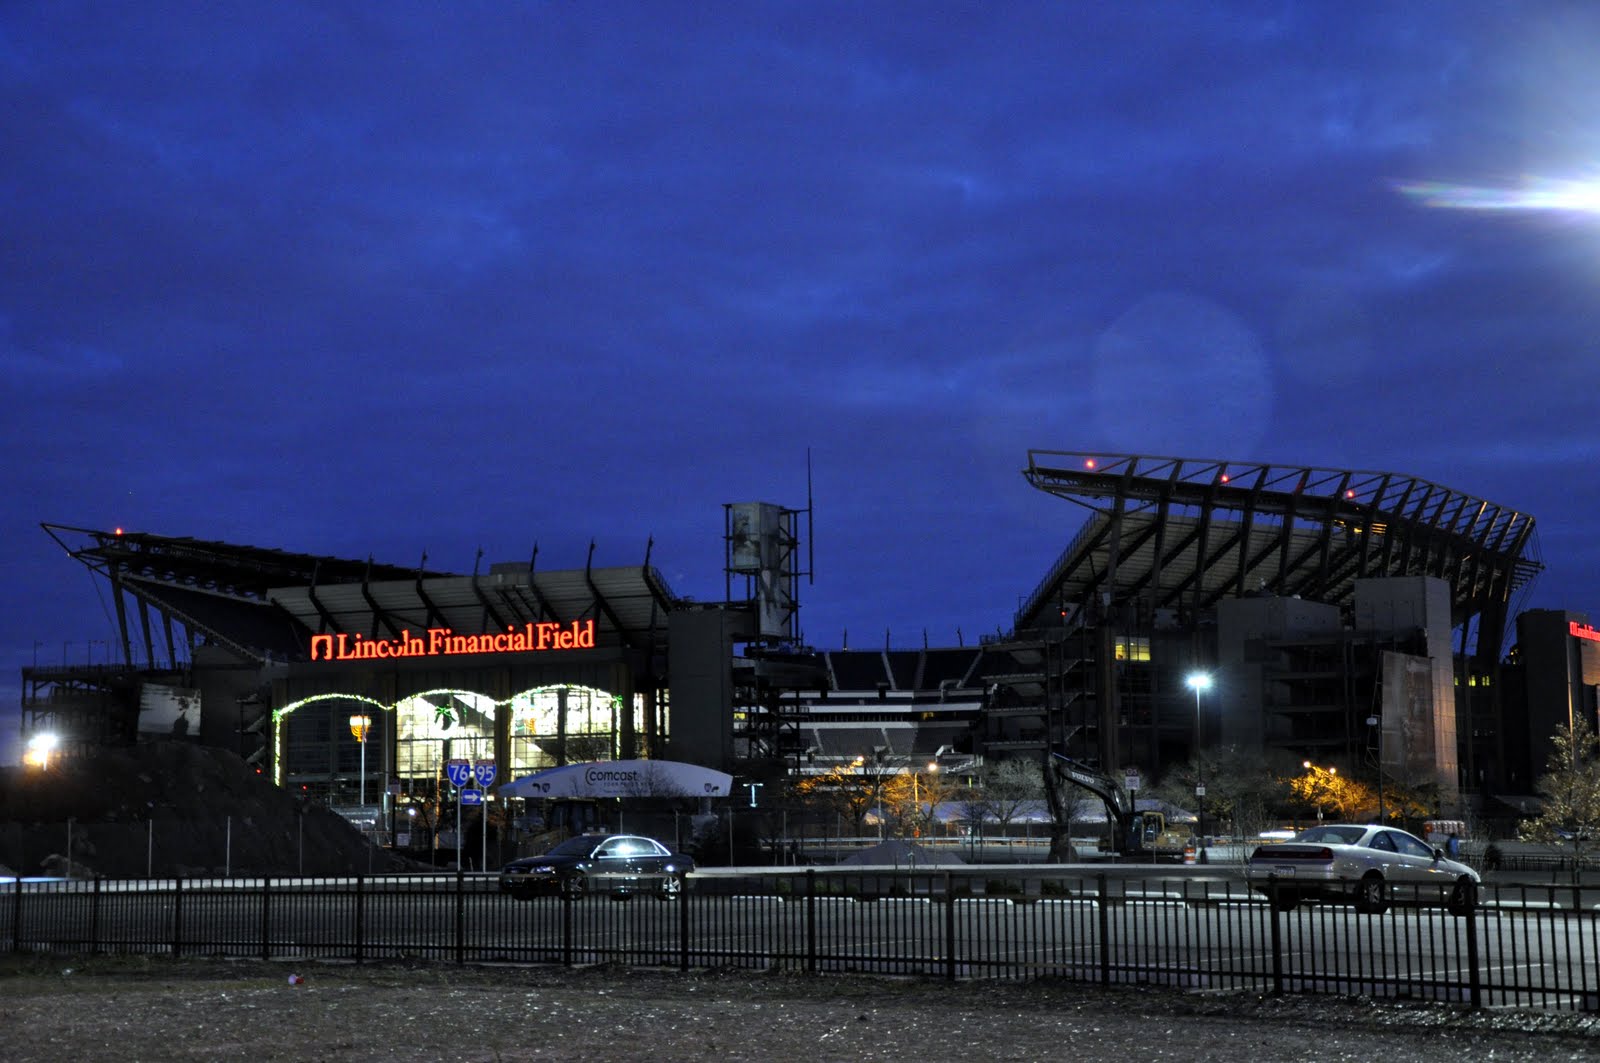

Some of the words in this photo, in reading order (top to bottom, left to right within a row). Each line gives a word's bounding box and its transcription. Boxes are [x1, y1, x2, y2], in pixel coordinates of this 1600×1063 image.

[336, 629, 426, 660] Lincoln
[427, 622, 535, 656] Financial
[535, 619, 595, 650] Field
[450, 765, 468, 781] 76
[476, 766, 494, 782] 95
[587, 769, 637, 782] comcast
[1071, 771, 1095, 784] VOLVO
